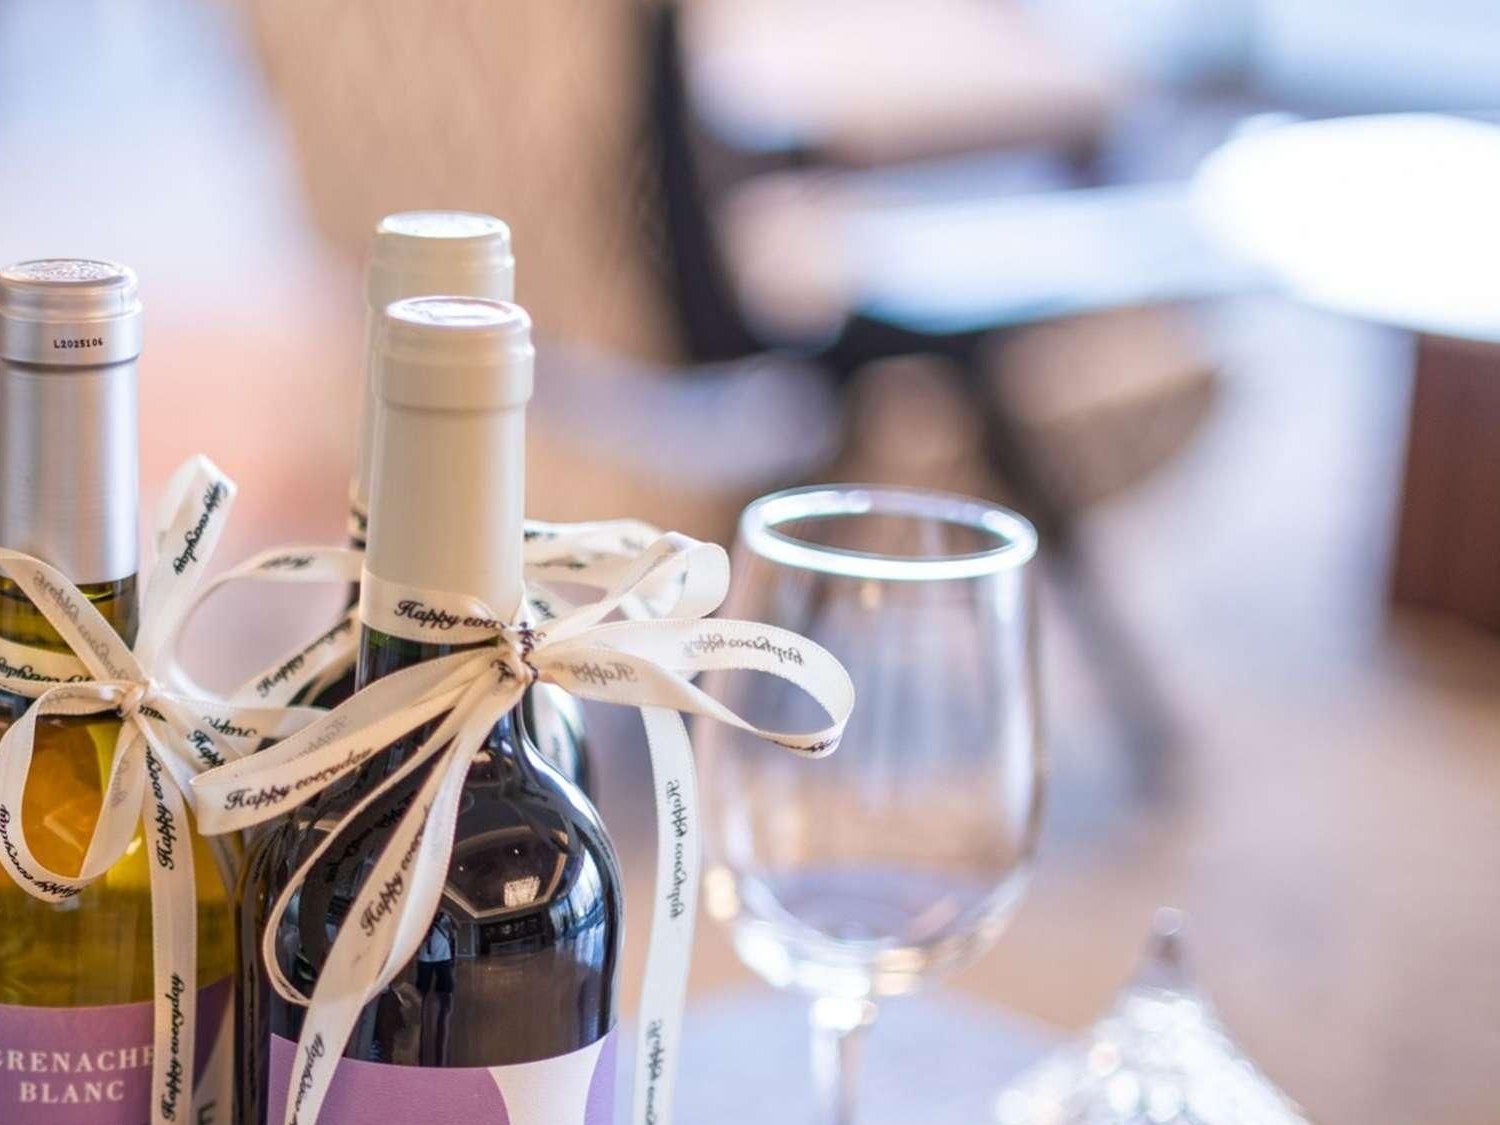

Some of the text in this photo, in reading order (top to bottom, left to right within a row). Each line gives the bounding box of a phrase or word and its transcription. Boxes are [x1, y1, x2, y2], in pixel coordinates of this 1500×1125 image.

[394, 599, 459, 631] Happy
[224, 784, 291, 811] Happy
[154, 801, 178, 870] Happy
[360, 871, 404, 937] Happy
[161, 972, 186, 1123] Happy everyday
[19, 1080, 126, 1104] BLANC
